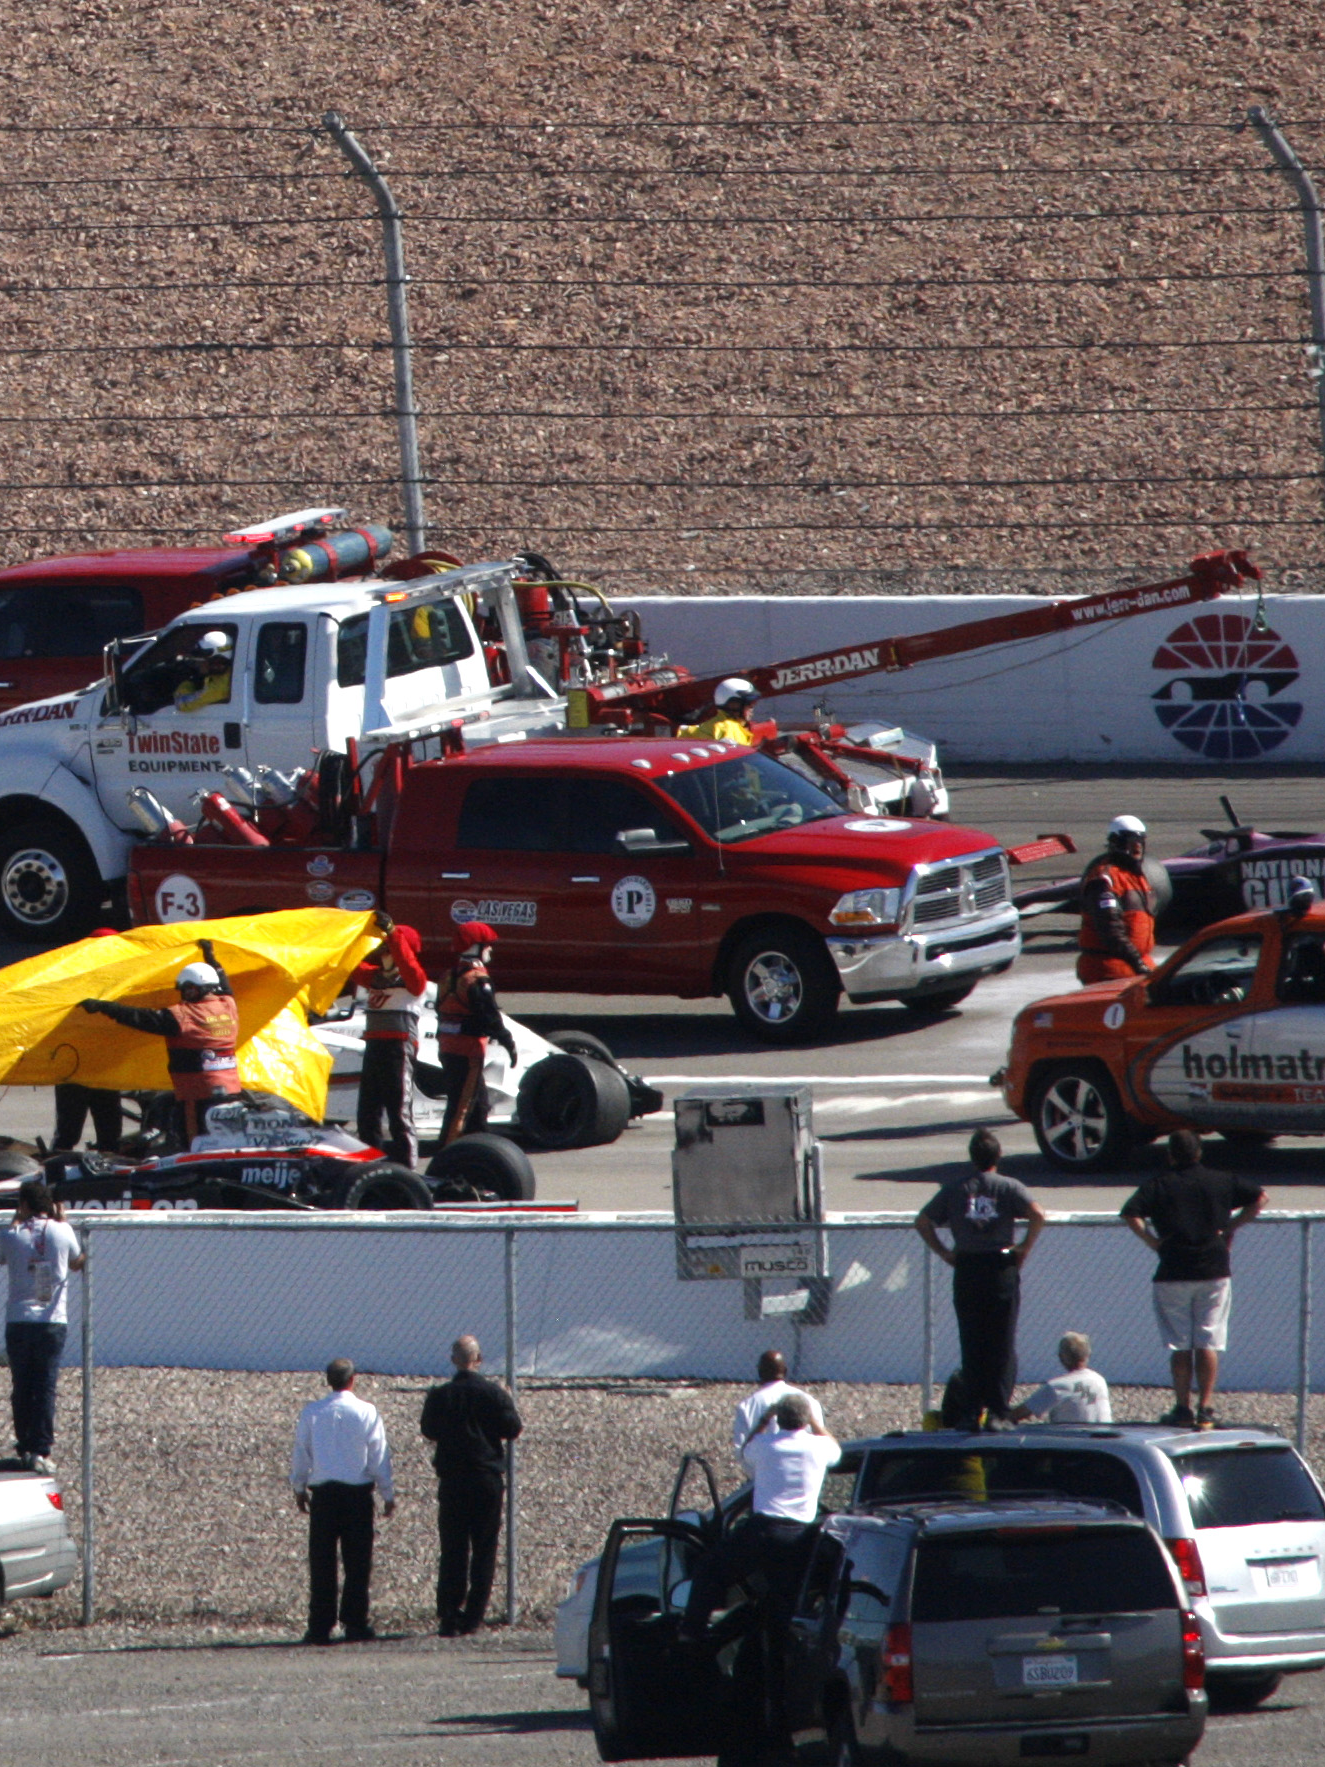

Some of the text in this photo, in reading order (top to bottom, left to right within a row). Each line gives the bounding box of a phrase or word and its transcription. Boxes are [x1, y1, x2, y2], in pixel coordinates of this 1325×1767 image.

[127, 731, 221, 755] TwinState
[129, 760, 221, 773] EQUIPMENT
[161, 892, 200, 917] F-3
[478, 901, 535, 918] LAS VEGAS
[627, 890, 643, 914] P
[744, 1260, 807, 1272] musco
